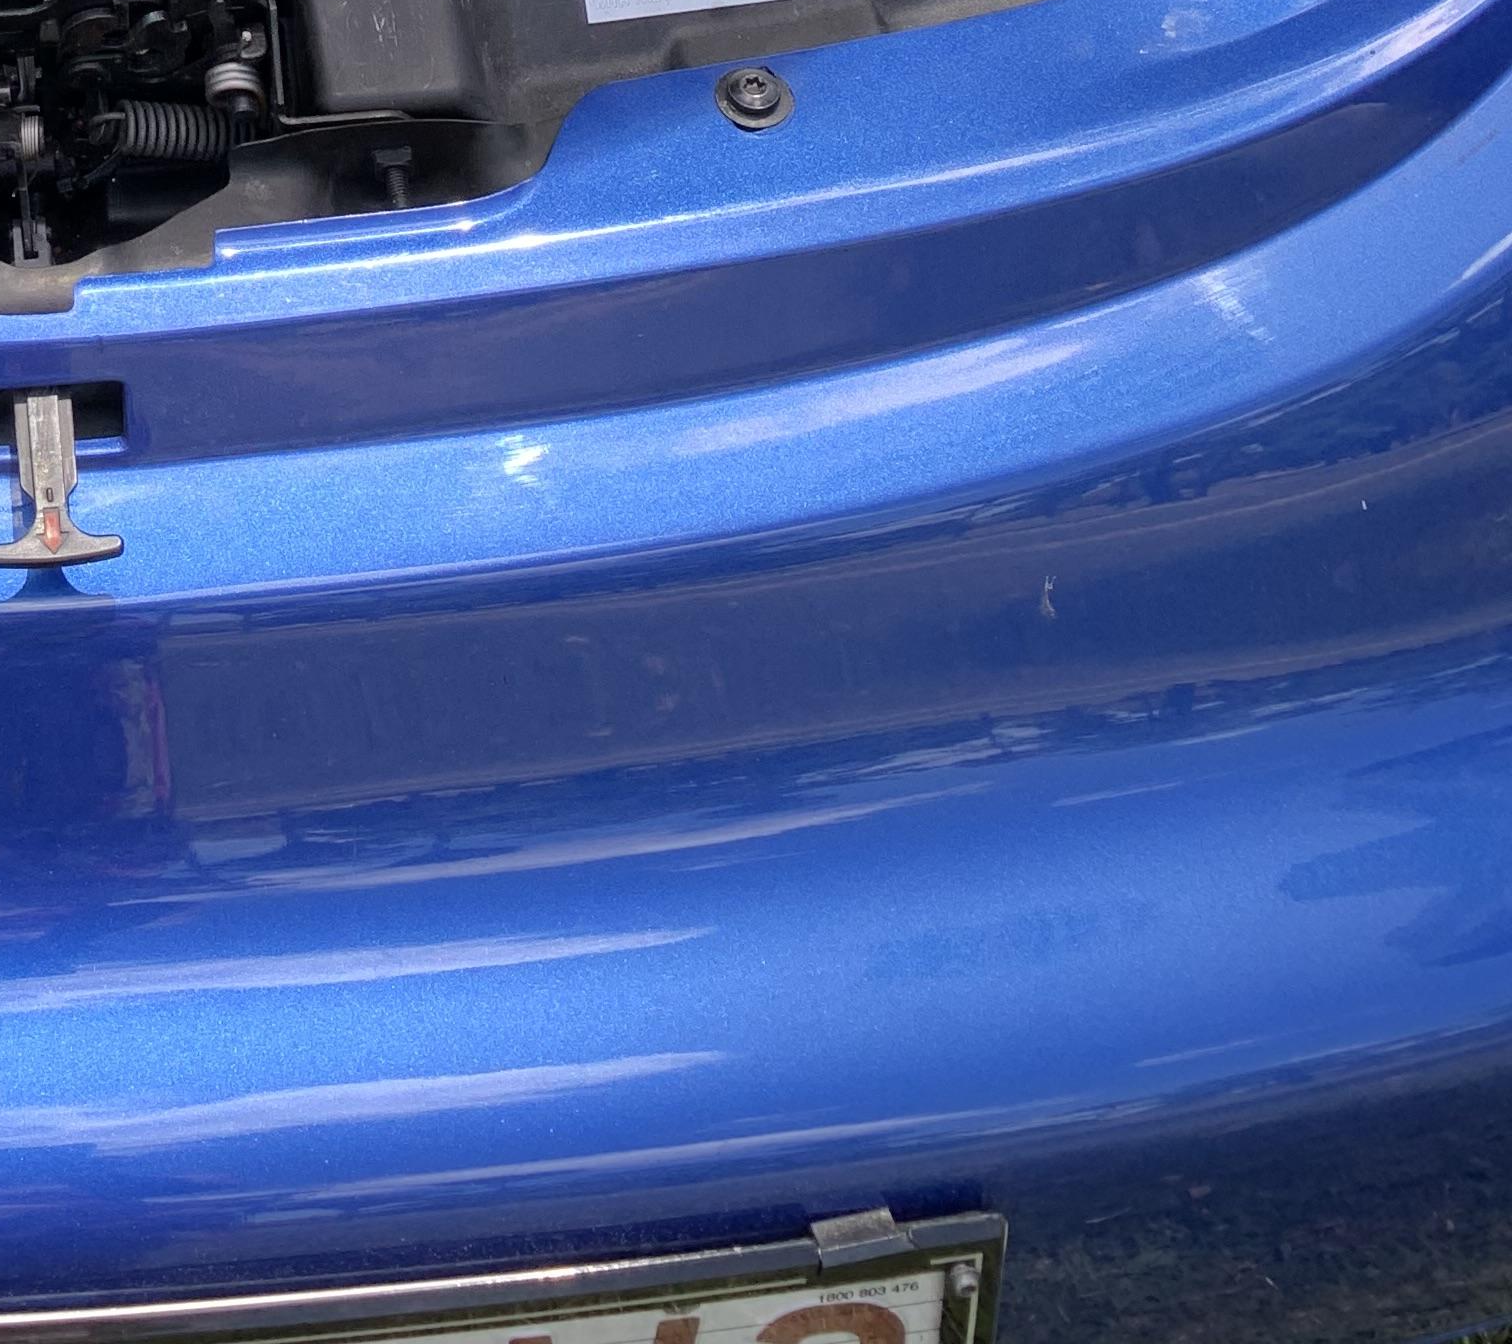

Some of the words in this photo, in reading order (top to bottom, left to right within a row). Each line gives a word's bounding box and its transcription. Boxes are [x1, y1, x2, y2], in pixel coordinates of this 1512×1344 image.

[819, 1290, 855, 1303] 1800
[859, 1285, 887, 1298] 803
[890, 1281, 920, 1294] 476
